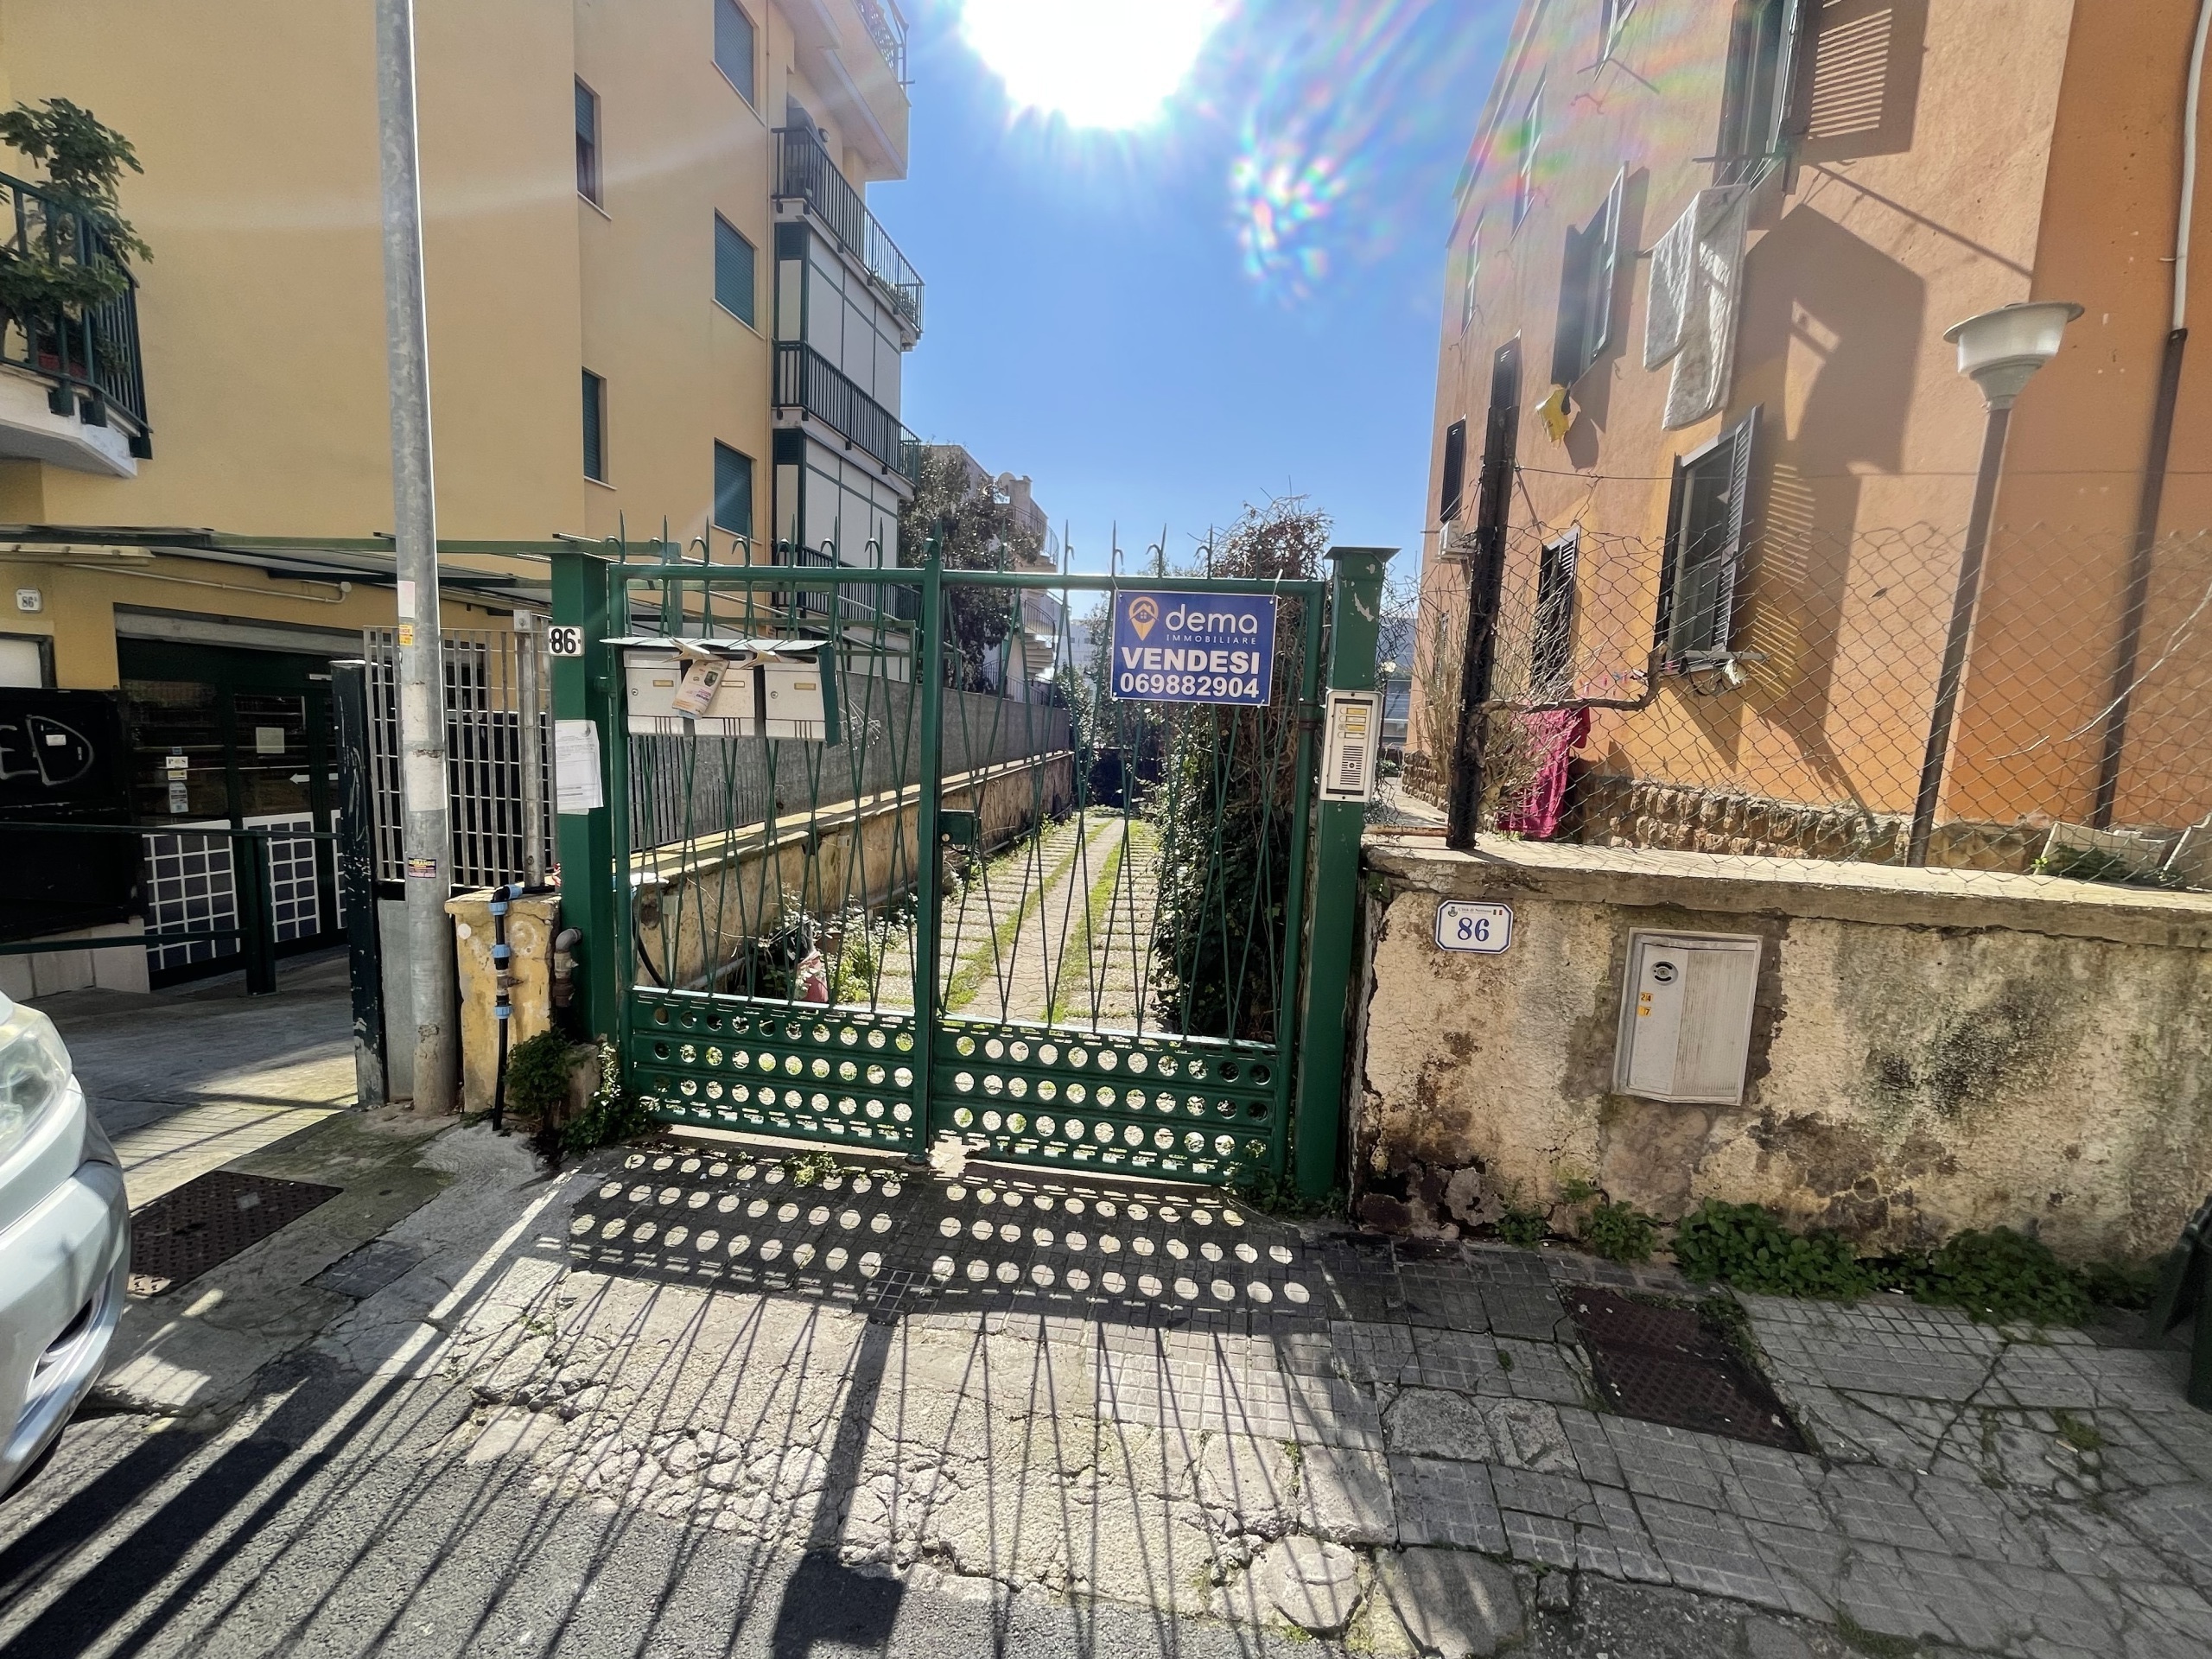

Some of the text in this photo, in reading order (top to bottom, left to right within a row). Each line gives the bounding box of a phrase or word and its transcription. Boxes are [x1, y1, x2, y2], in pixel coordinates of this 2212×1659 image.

[1166, 604, 1258, 634] dema
[551, 627, 576, 654] 86
[1166, 634, 1256, 645] IMMOBILIARE
[1121, 646, 1261, 675] VENDESI
[1120, 672, 1260, 698] 069882904
[1457, 917, 1490, 942] 86
